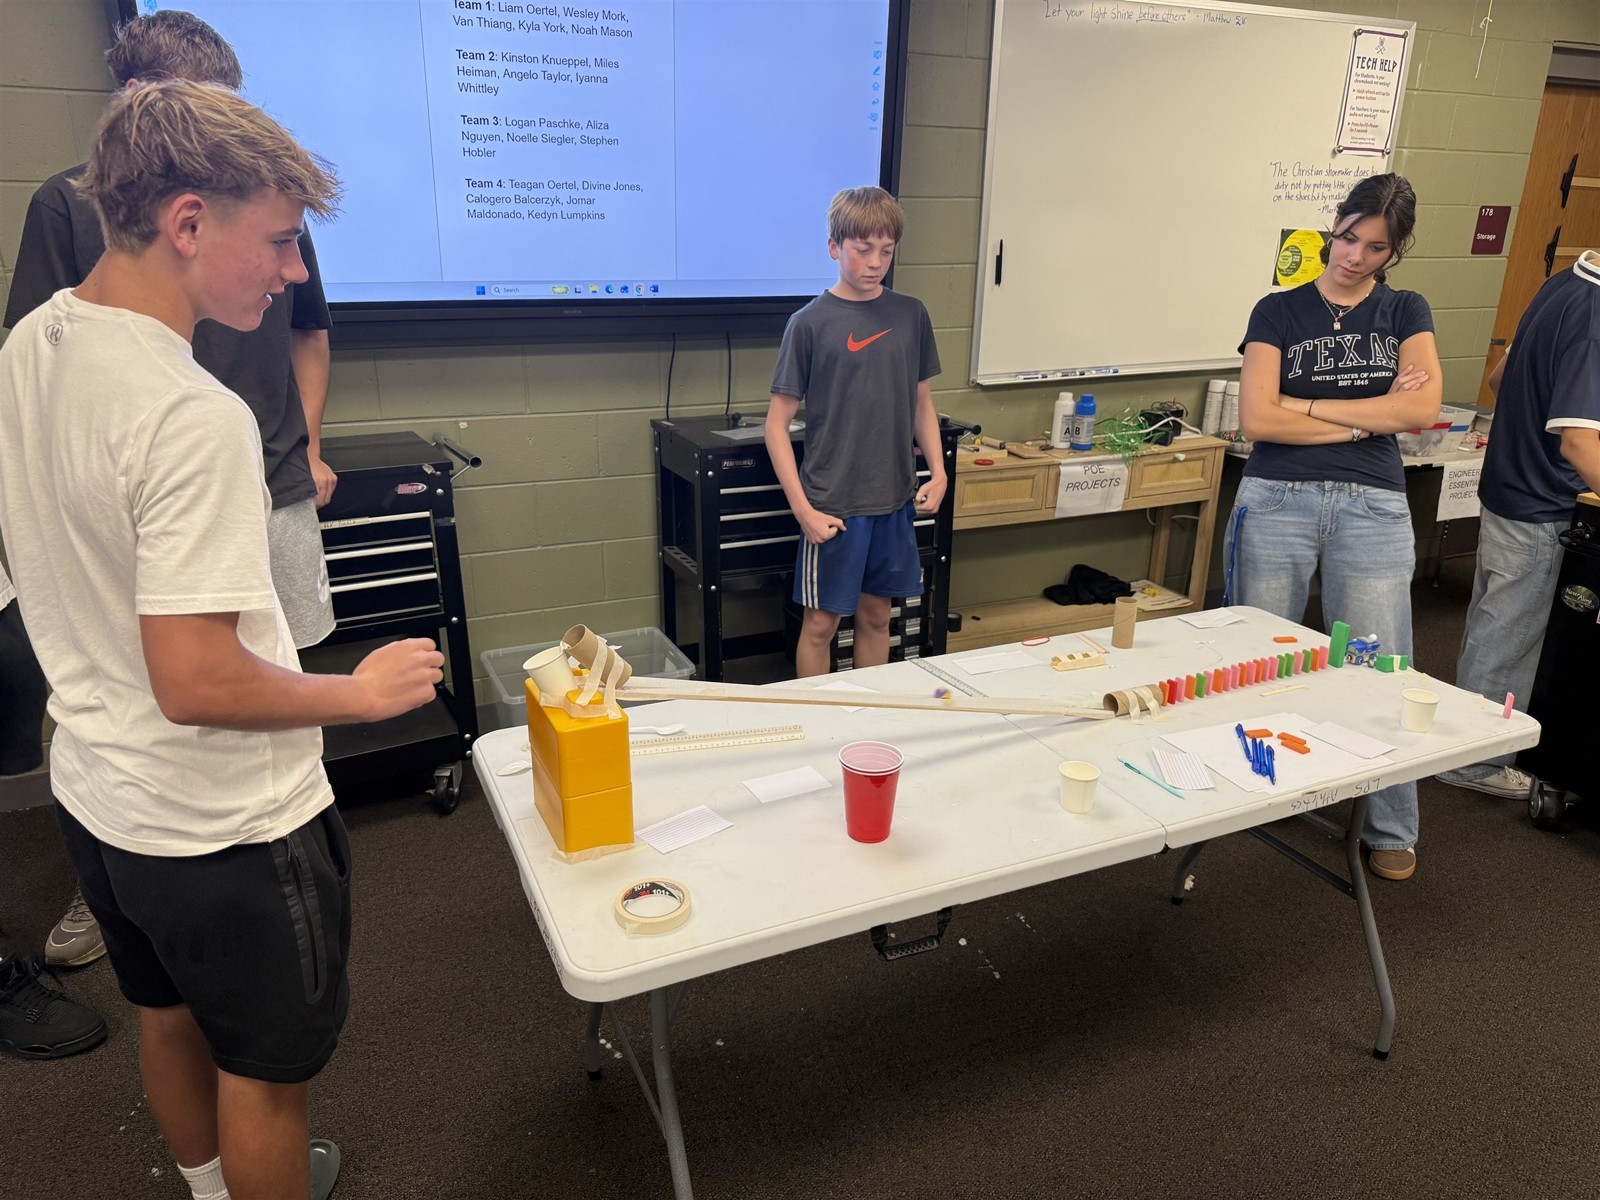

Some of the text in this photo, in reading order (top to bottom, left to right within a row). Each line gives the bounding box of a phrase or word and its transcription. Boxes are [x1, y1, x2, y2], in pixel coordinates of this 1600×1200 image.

[454, 0, 629, 22] Team 1: Liam Oertel, Wesley Mork,
[1066, 9, 1085, 21] your
[1090, 2, 1107, 24] light
[1138, 7, 1160, 20] before
[453, 15, 633, 38] Van Thiang, Kyla York, Noah Mason
[456, 49, 620, 69] Team 2: Kinston Knueppel, Miles
[1356, 56, 1397, 72] TECH HELP
[457, 66, 500, 79] Heiman,
[503, 68, 539, 82] Angelo
[541, 70, 573, 84] Taylor,
[458, 82, 499, 96] Whittley
[460, 115, 609, 130] Team 3: Logan Paschke, Aliza
[461, 131, 619, 147] Nguyen, Noelle Siegler, Stephen
[463, 147, 496, 157] Hobler
[1292, 161, 1323, 178] Christian
[1325, 163, 1353, 177] shoemaker
[1353, 165, 1369, 177] does
[465, 178, 644, 192] Team 4: Teagan Oertel, Divine Jones,
[1274, 181, 1288, 190] duty
[1290, 181, 1301, 189] not
[1303, 180, 1311, 191] by
[1312, 181, 1331, 193] putting
[1333, 180, 1345, 189] little
[466, 194, 595, 207] Calogero Balcerzyk, Jomar
[1272, 191, 1347, 203] on the shoes but by makin
[467, 209, 605, 221] Maldonado, Kedyn Lumpkins
[1482, 208, 1493, 216] 178
[1476, 233, 1496, 241] Storage
[1288, 333, 1399, 379] TEXAS
[1064, 427, 1070, 435] A
[1075, 426, 1080, 435] B
[1083, 464, 1105, 476] POE
[1448, 469, 1480, 478] ENGINEER
[1066, 477, 1121, 492] PROJECTS
[1448, 480, 1478, 489] ESSENTIA
[1448, 490, 1478, 500] PROJECT
[634, 882, 651, 891] 101+
